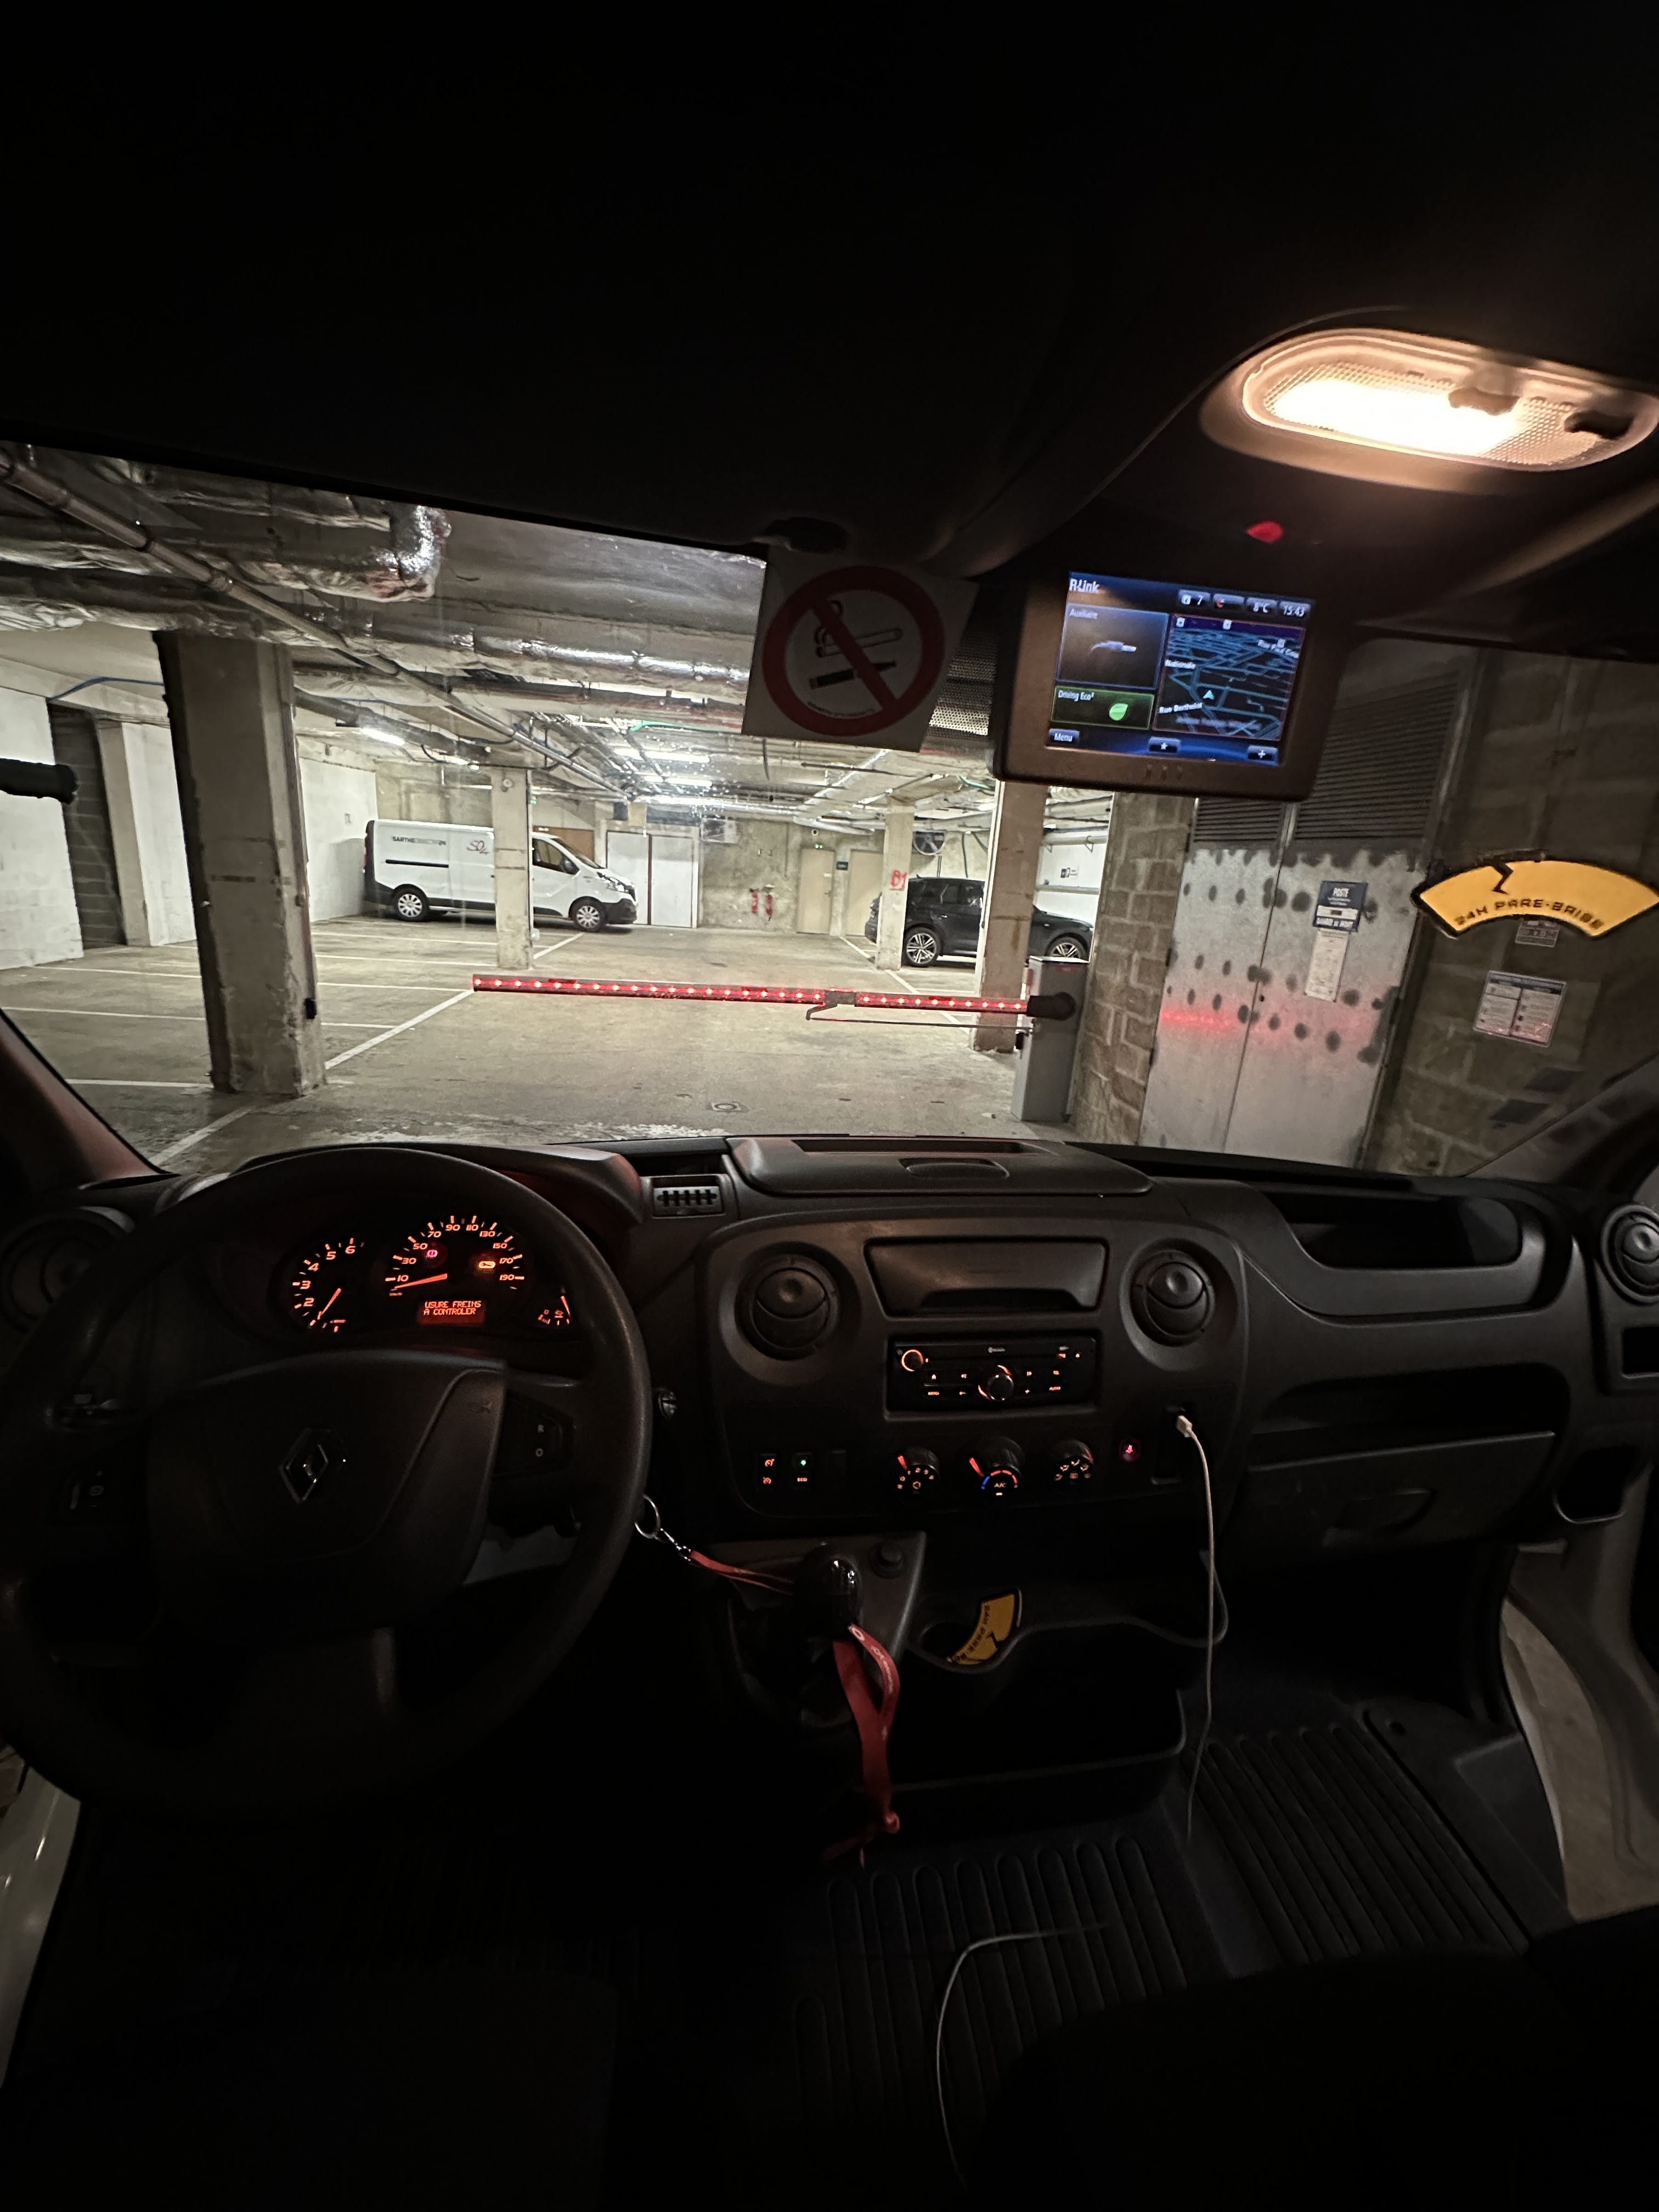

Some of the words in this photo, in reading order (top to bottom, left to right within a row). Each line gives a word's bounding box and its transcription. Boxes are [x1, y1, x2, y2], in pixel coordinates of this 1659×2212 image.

[1058, 690, 1079, 702] Driving
[1054, 733, 1073, 742] Menu
[345, 1245, 356, 1254] 6
[326, 1251, 336, 1260] 5
[308, 1262, 319, 1272] 4
[300, 1280, 311, 1289] 3
[303, 1297, 314, 1306] 2
